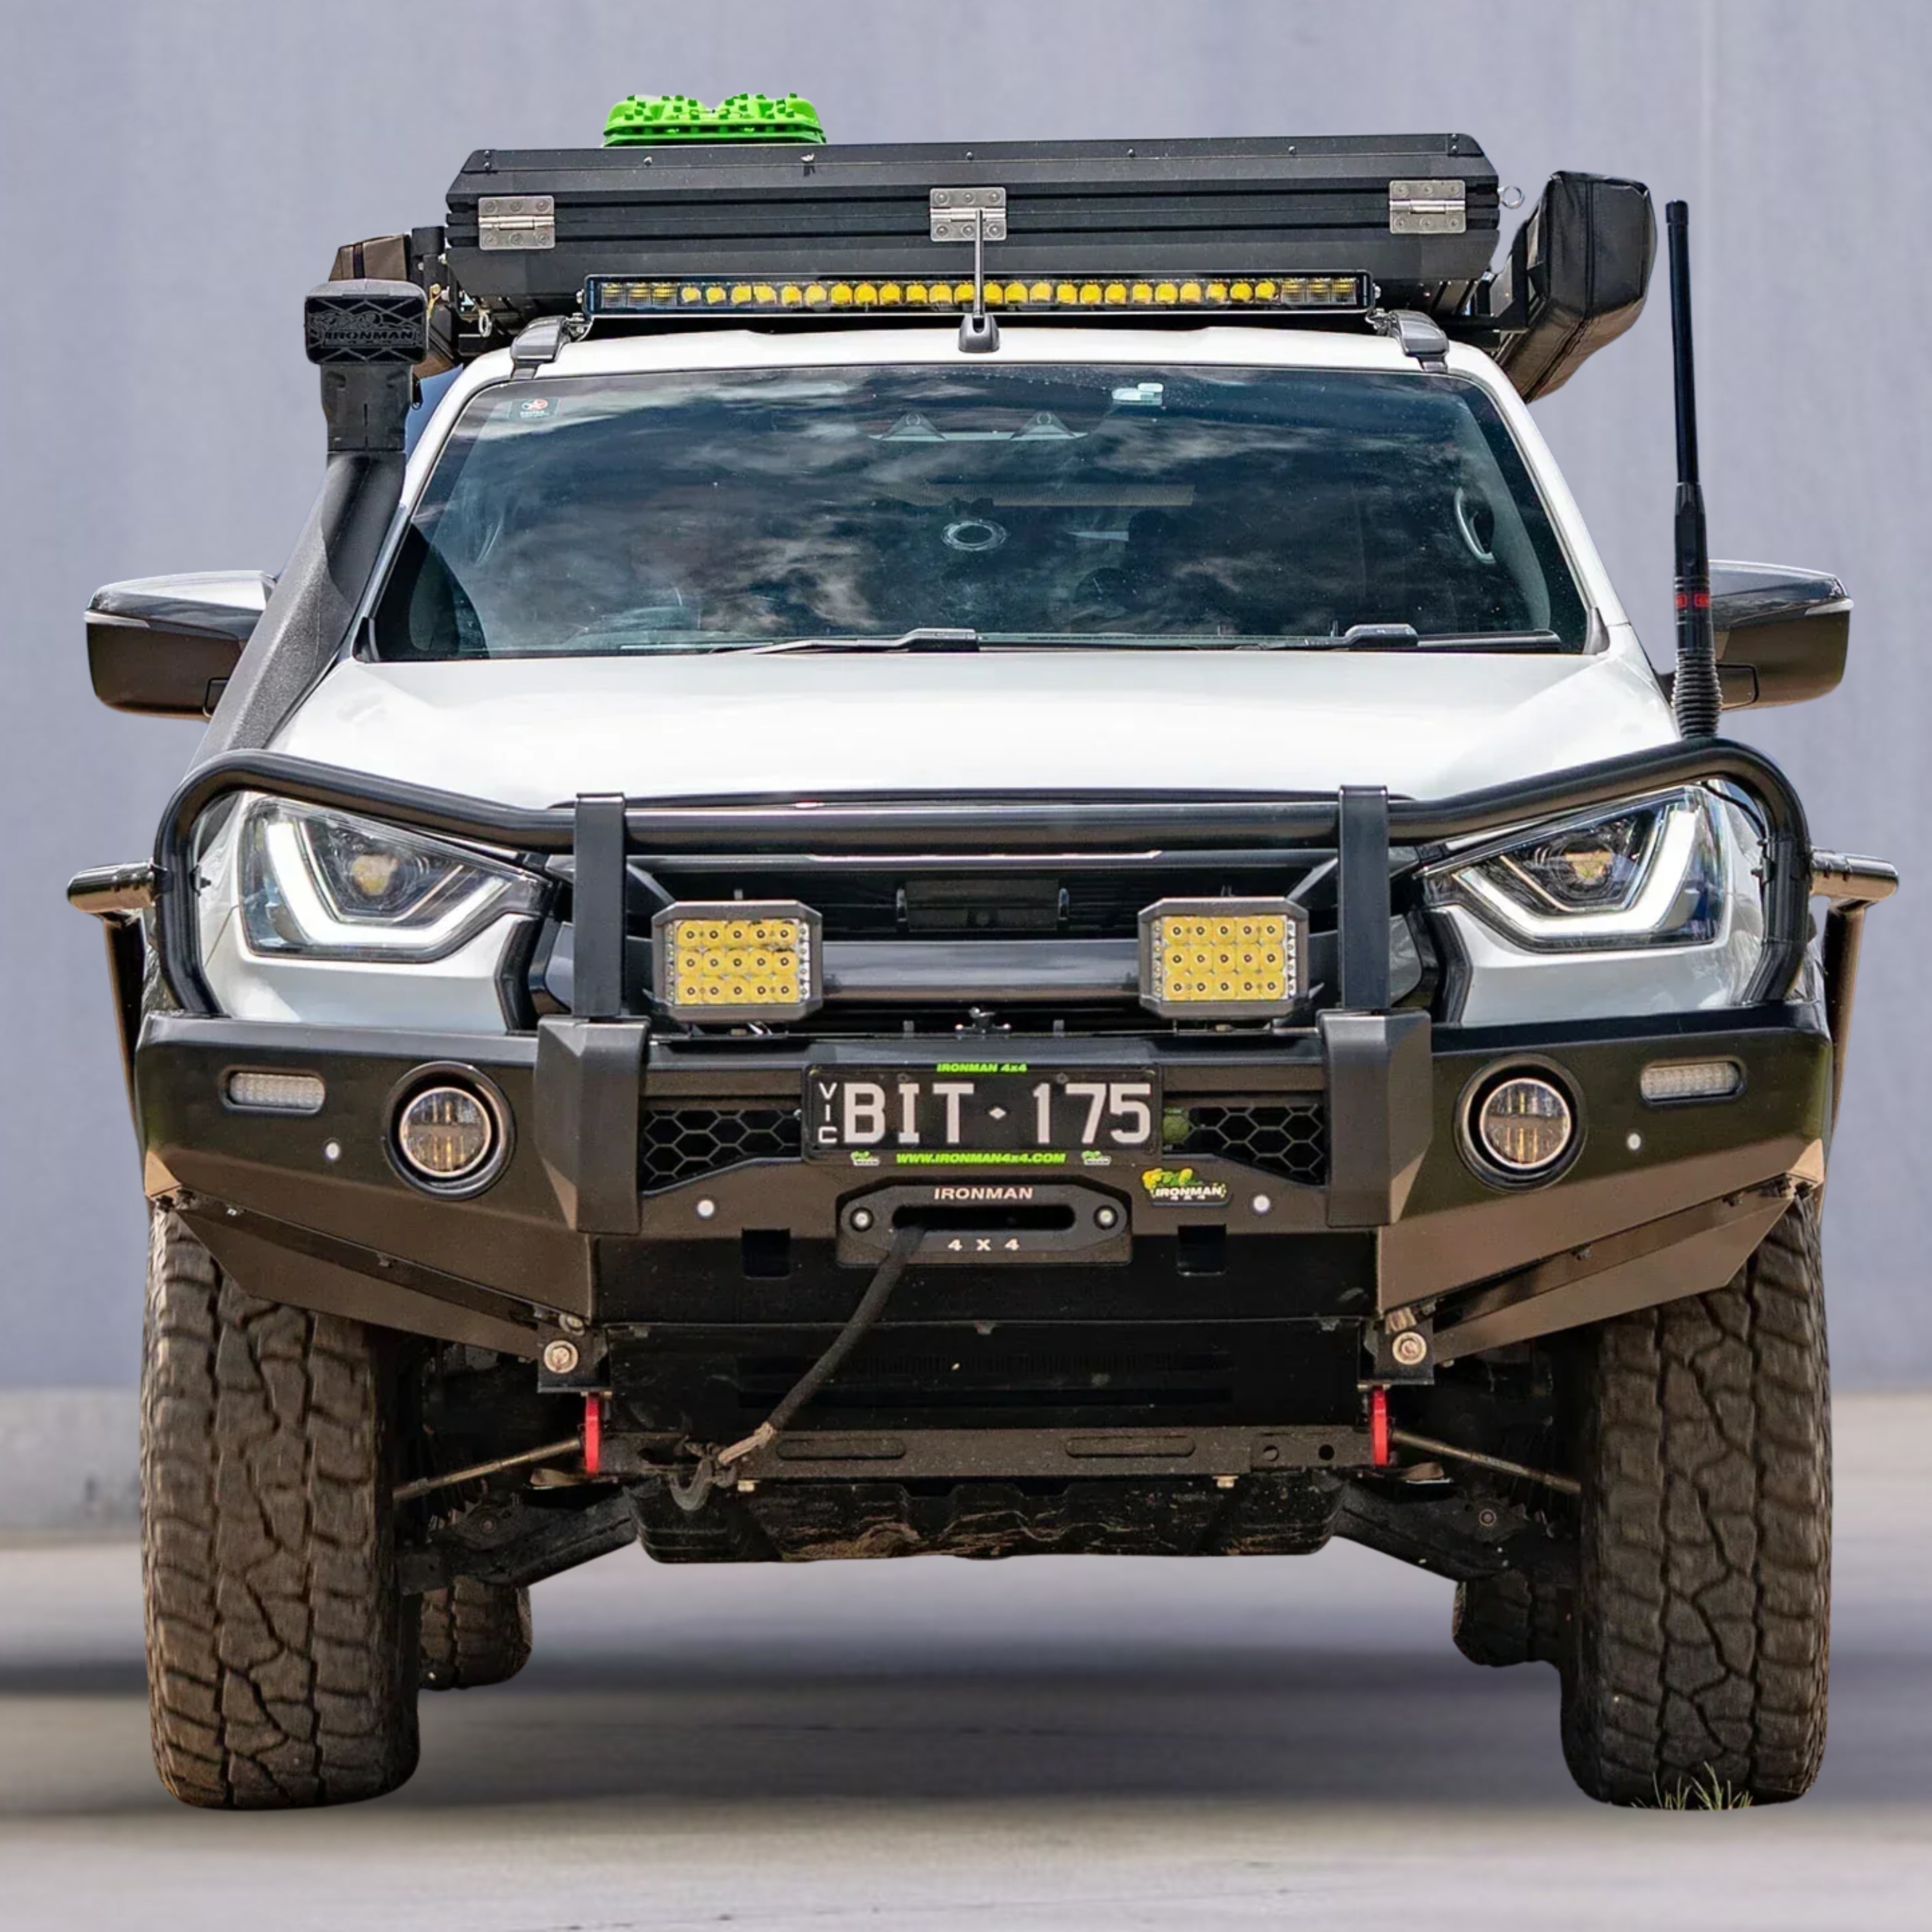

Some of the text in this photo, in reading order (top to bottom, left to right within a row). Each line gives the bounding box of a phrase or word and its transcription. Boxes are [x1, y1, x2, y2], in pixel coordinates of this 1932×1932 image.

[325, 331, 413, 340] IRONMAN
[937, 1063, 998, 1072] IRONMAN
[818, 1082, 837, 1143] VIC
[844, 1082, 1151, 1144] BIT 175
[896, 1153, 1066, 1163] WWW.IRONMAN4x4.COM
[934, 1188, 1032, 1199] IRONMAN
[1155, 1187, 1222, 1197] IRONMAN
